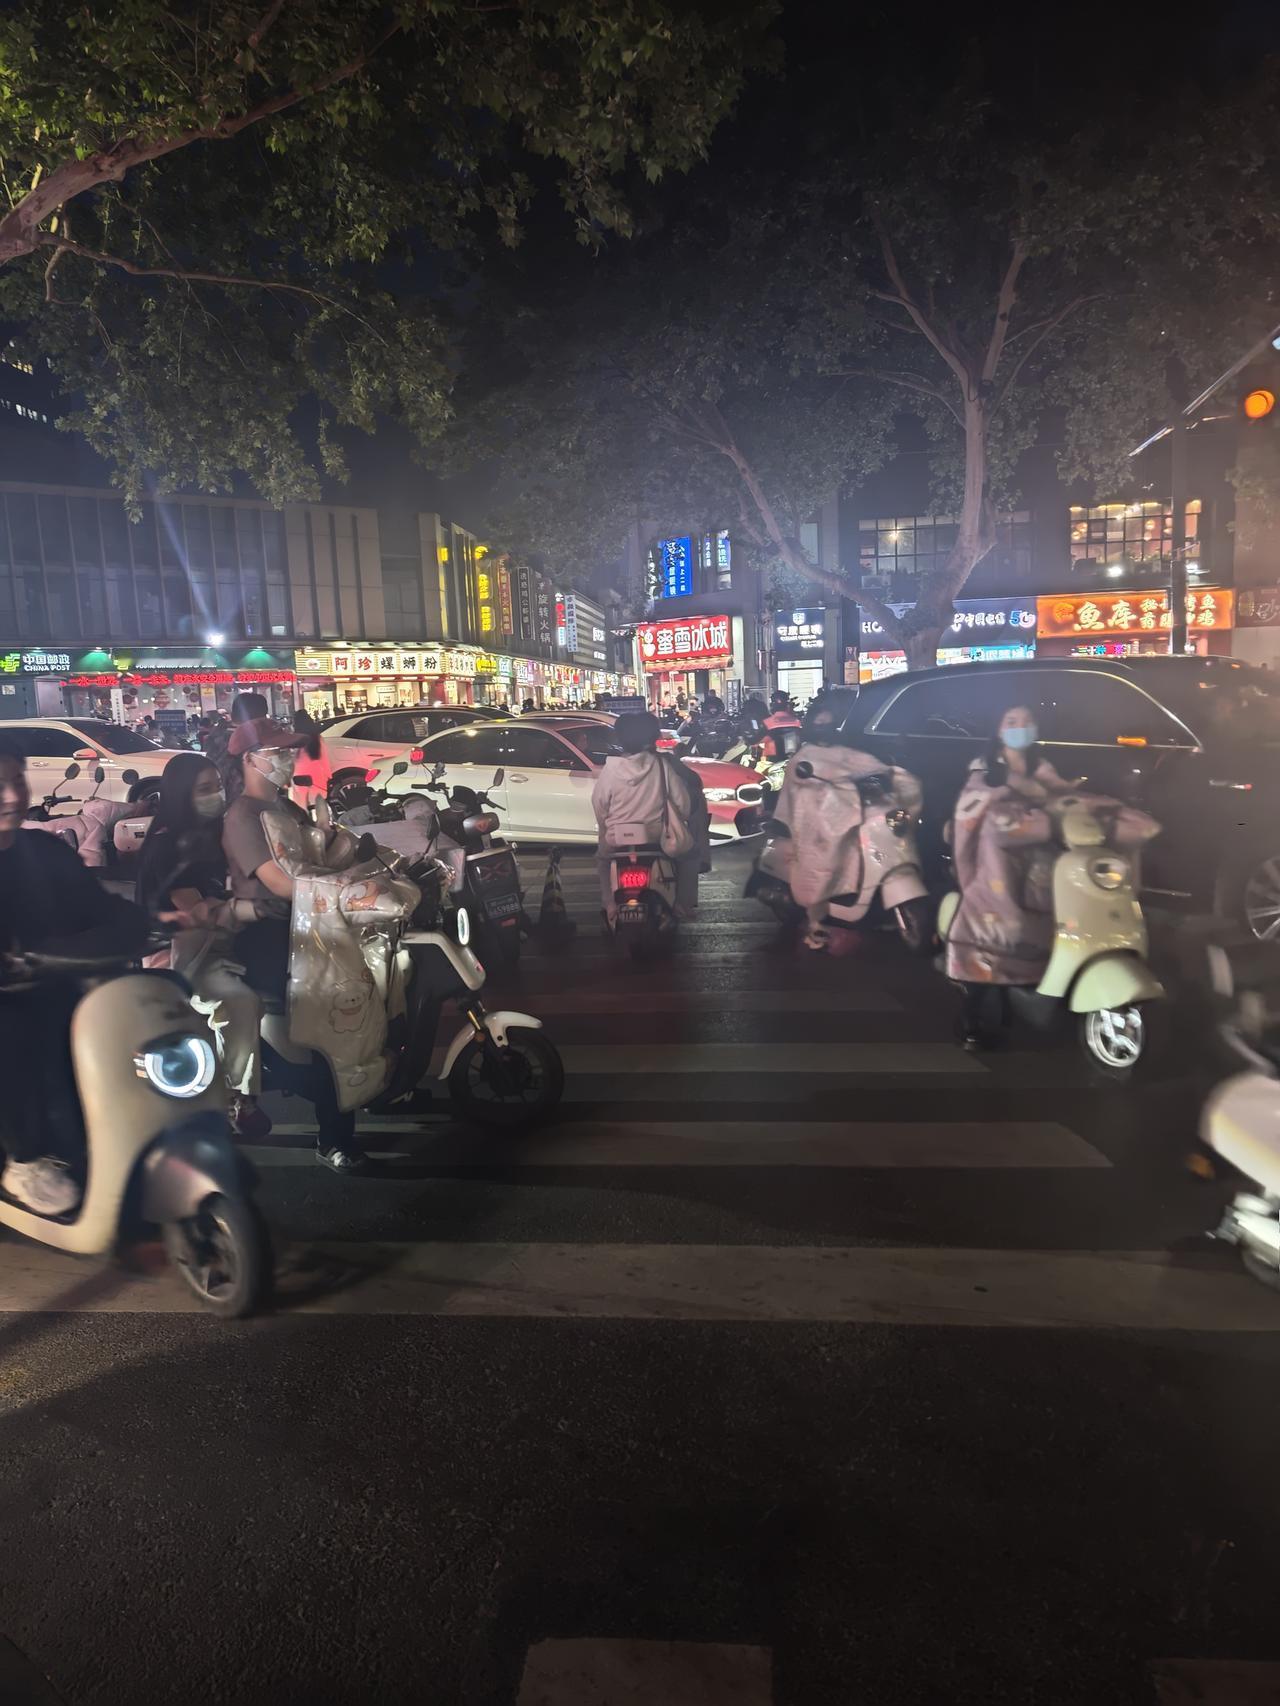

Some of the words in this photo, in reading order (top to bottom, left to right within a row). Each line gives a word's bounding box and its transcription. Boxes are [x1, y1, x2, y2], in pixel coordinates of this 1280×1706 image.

[656, 620, 729, 655] 蜜雪冰城
[23, 653, 71, 665] 中国邮政
[334, 655, 438, 671] 阿珍螺蛳粉
[24, 664, 49, 672] CHINA
